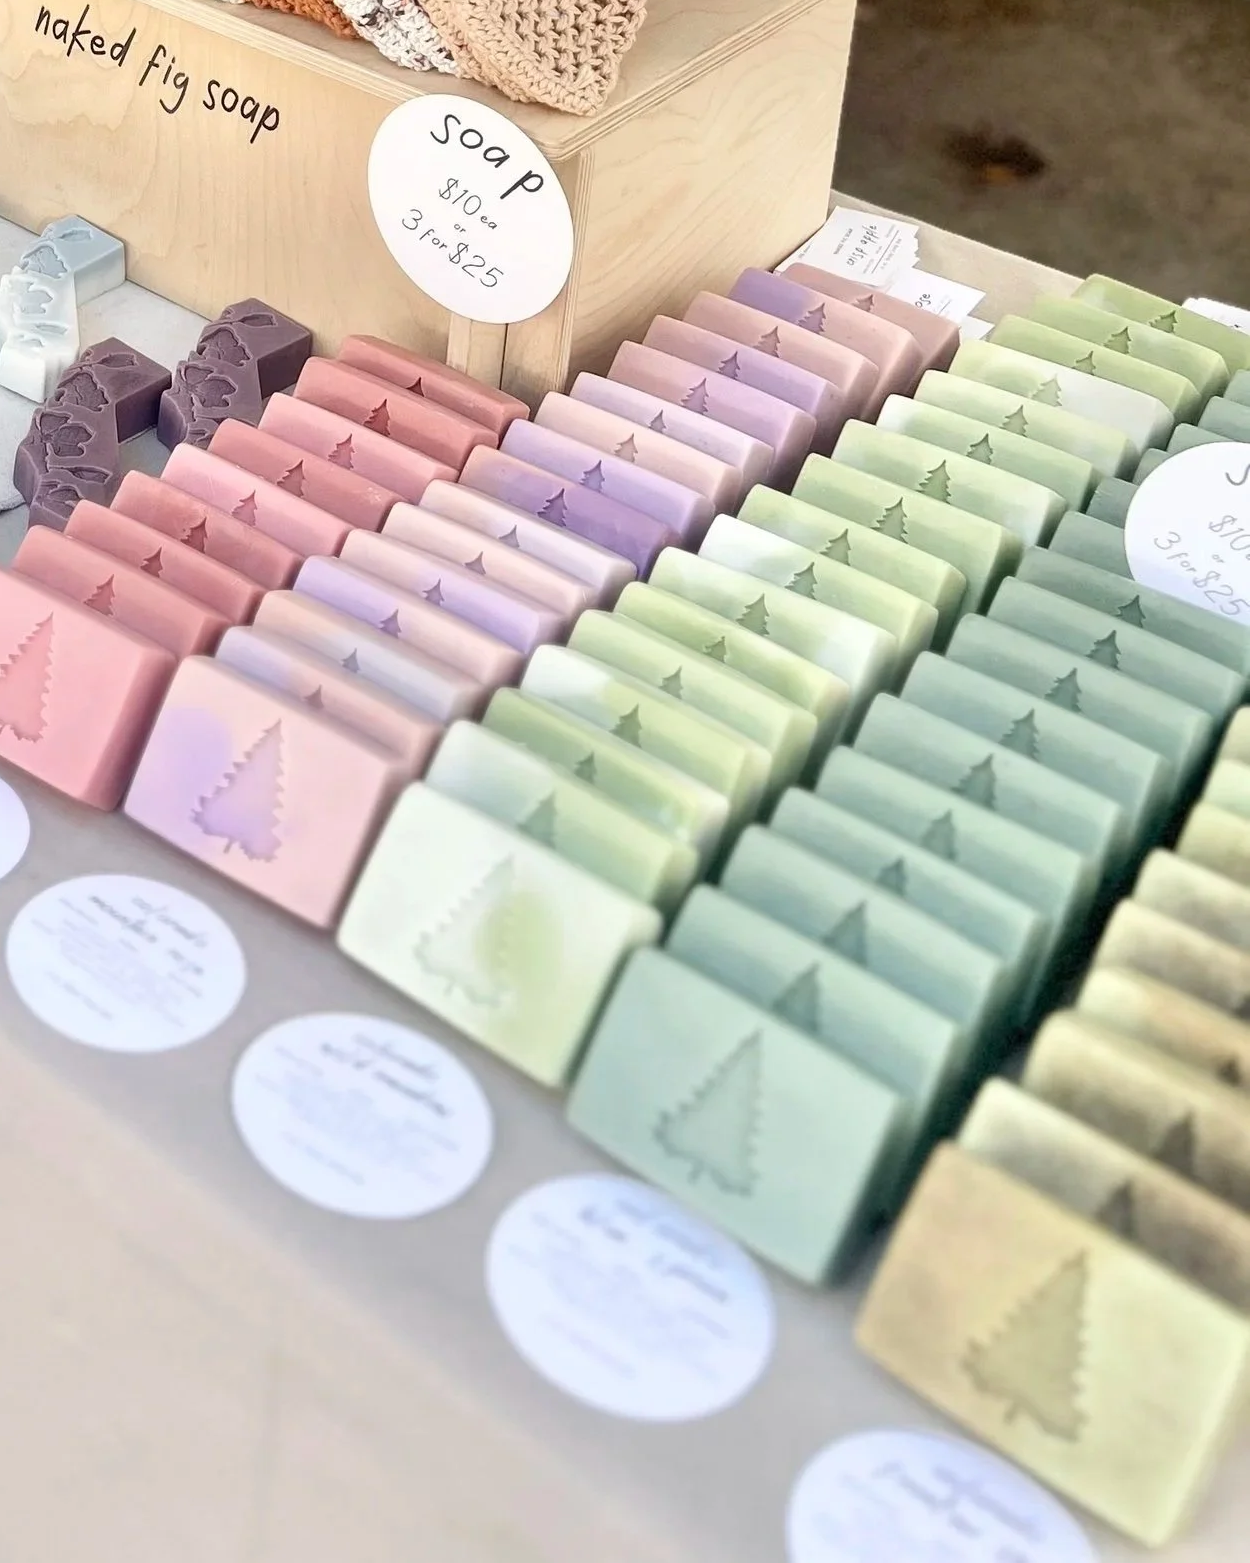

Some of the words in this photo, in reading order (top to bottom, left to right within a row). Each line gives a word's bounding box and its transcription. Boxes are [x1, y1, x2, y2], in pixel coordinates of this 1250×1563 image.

[33, 3, 138, 68] naked
[138, 44, 189, 114] fig
[202, 78, 281, 145] soap
[429, 114, 545, 200] soap
[437, 177, 483, 217] $10
[480, 213, 499, 231] ea
[401, 208, 423, 232] 3
[419, 227, 449, 251] for
[448, 242, 505, 289] $25
[453, 222, 467, 235] or
[846, 244, 868, 266] crisp
[861, 224, 878, 247] apple
[914, 292, 931, 310] ose
[1152, 531, 1181, 551] 3
[1166, 550, 1198, 574] for
[1211, 553, 1225, 564] or
[1192, 570, 1250, 616] $25
